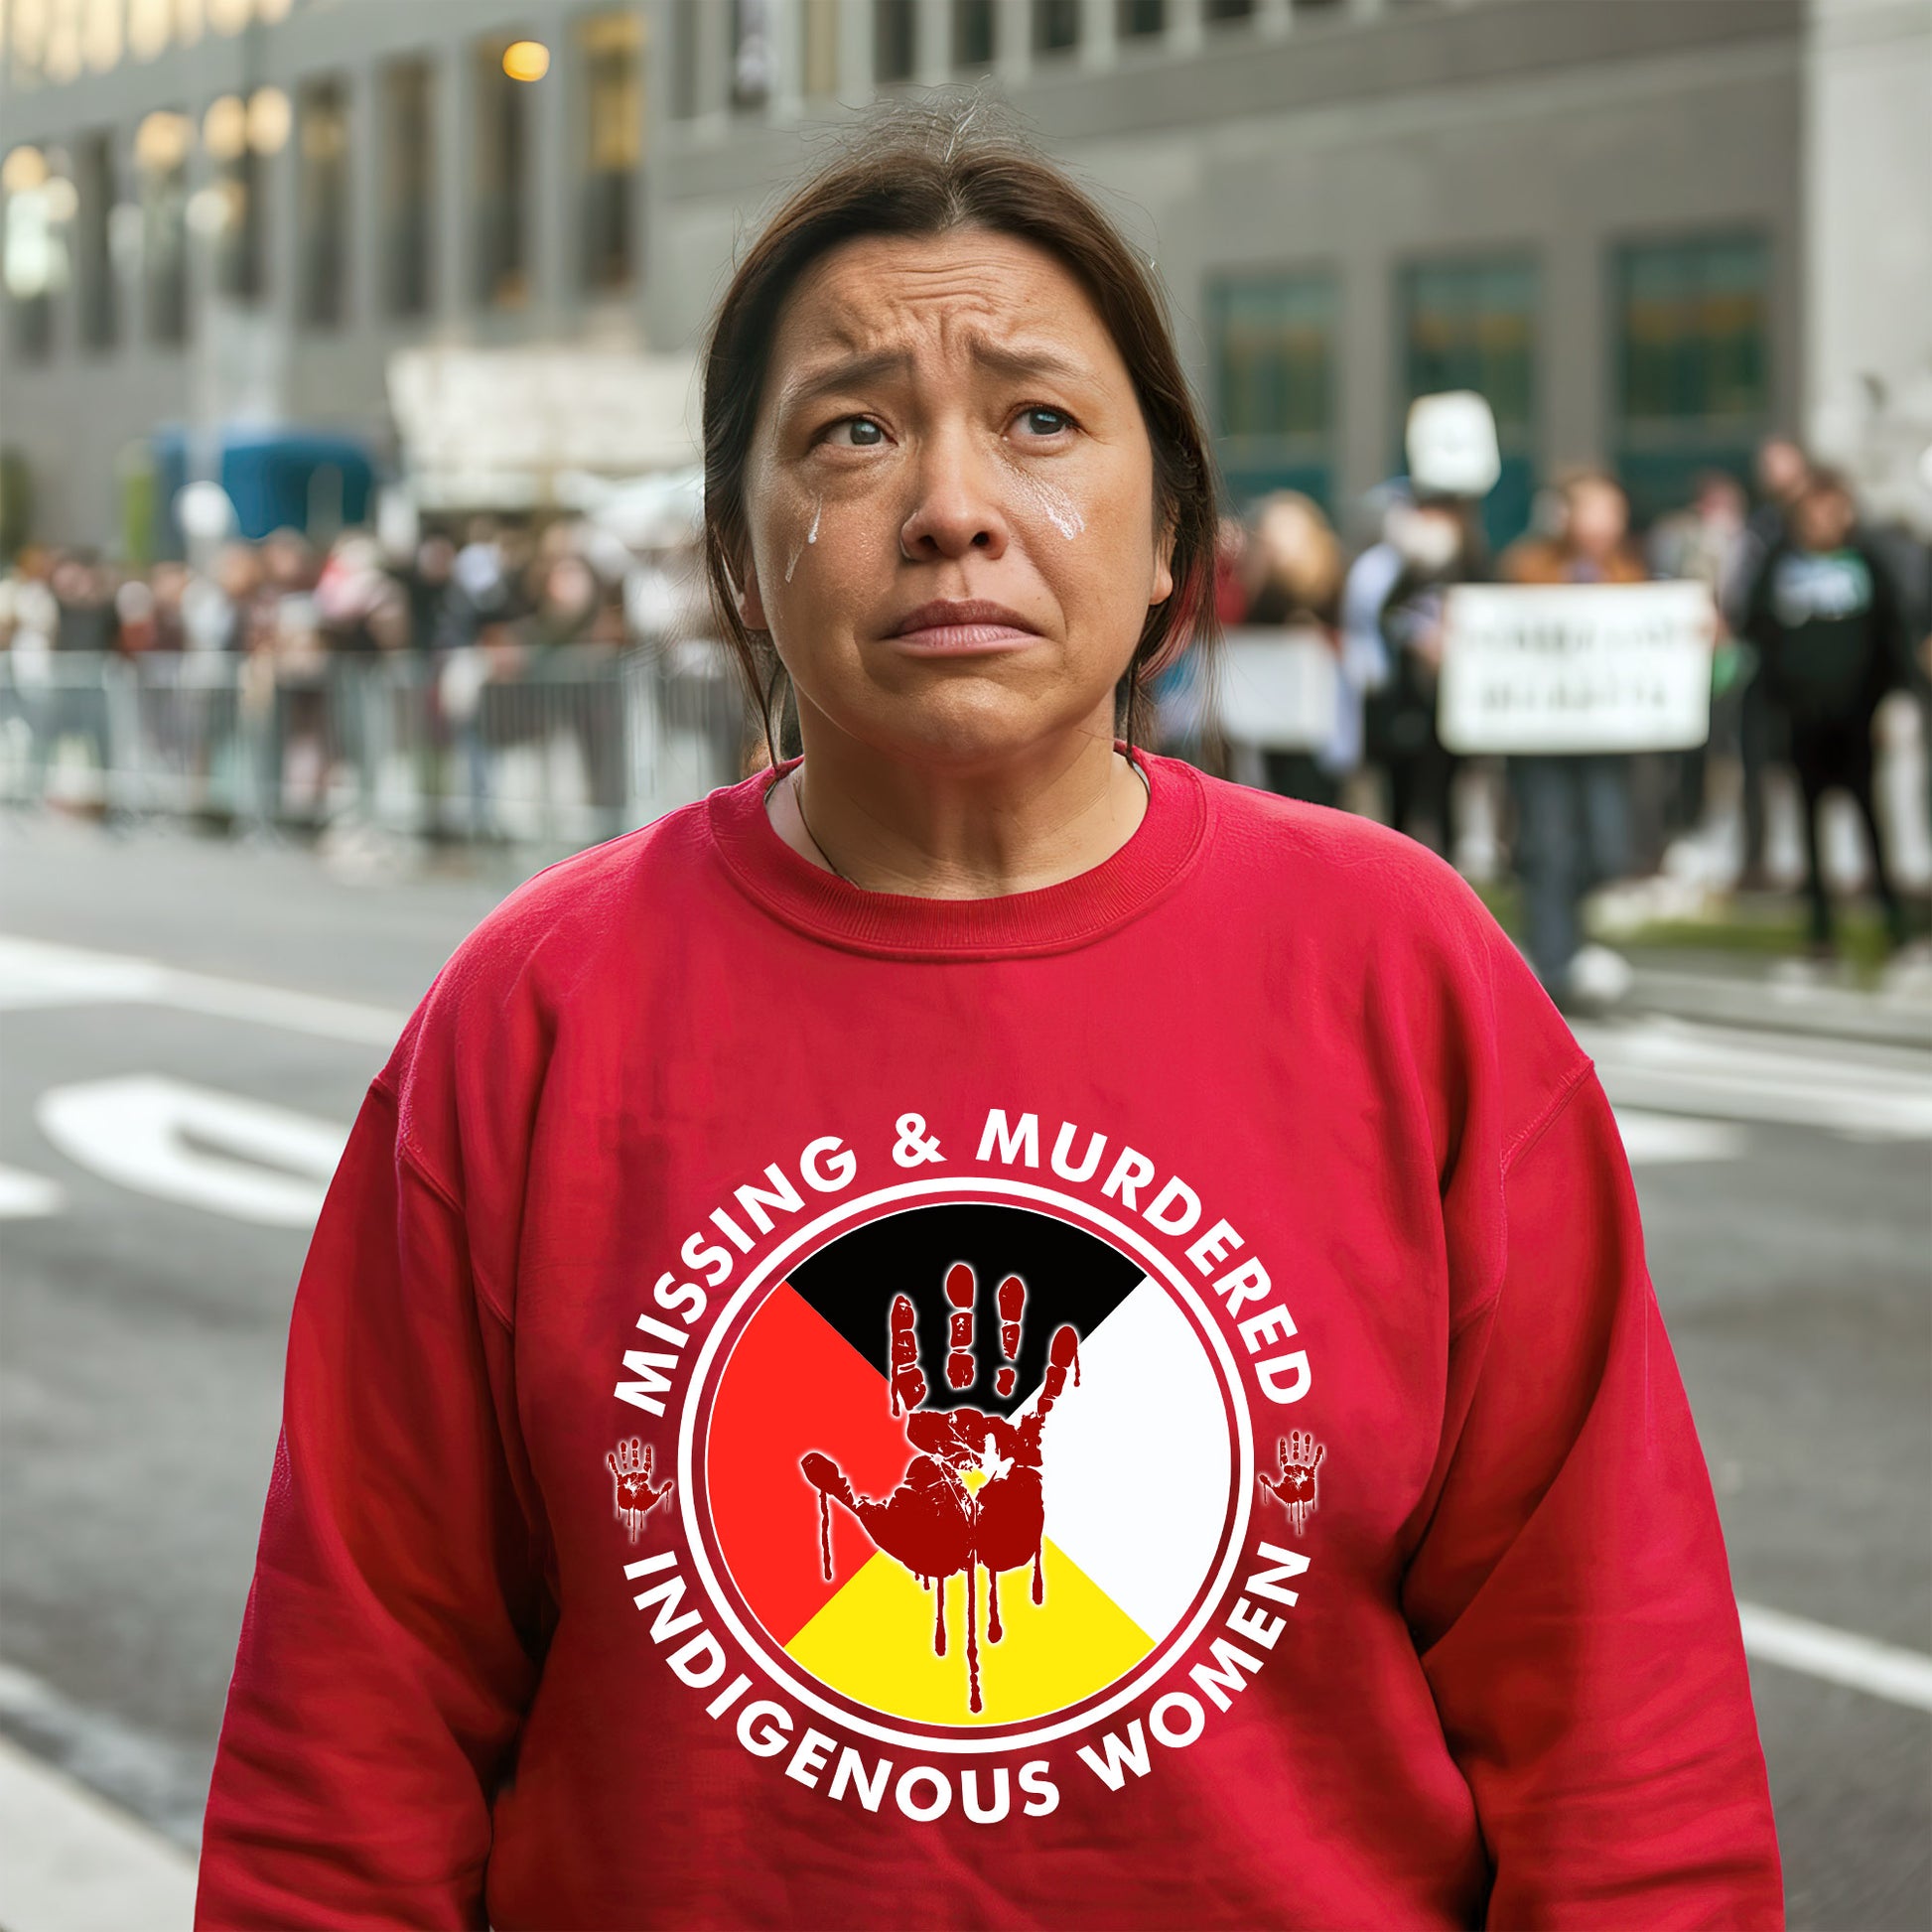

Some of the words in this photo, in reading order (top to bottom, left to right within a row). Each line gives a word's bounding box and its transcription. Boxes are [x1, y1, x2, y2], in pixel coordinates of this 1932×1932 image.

[614, 1136, 857, 1418] MISSING
[892, 1112, 947, 1169] &
[975, 1108, 1311, 1405] MURDERED
[622, 1550, 1060, 1824] INDIGENOUS
[1075, 1541, 1311, 1792] WOMEN
